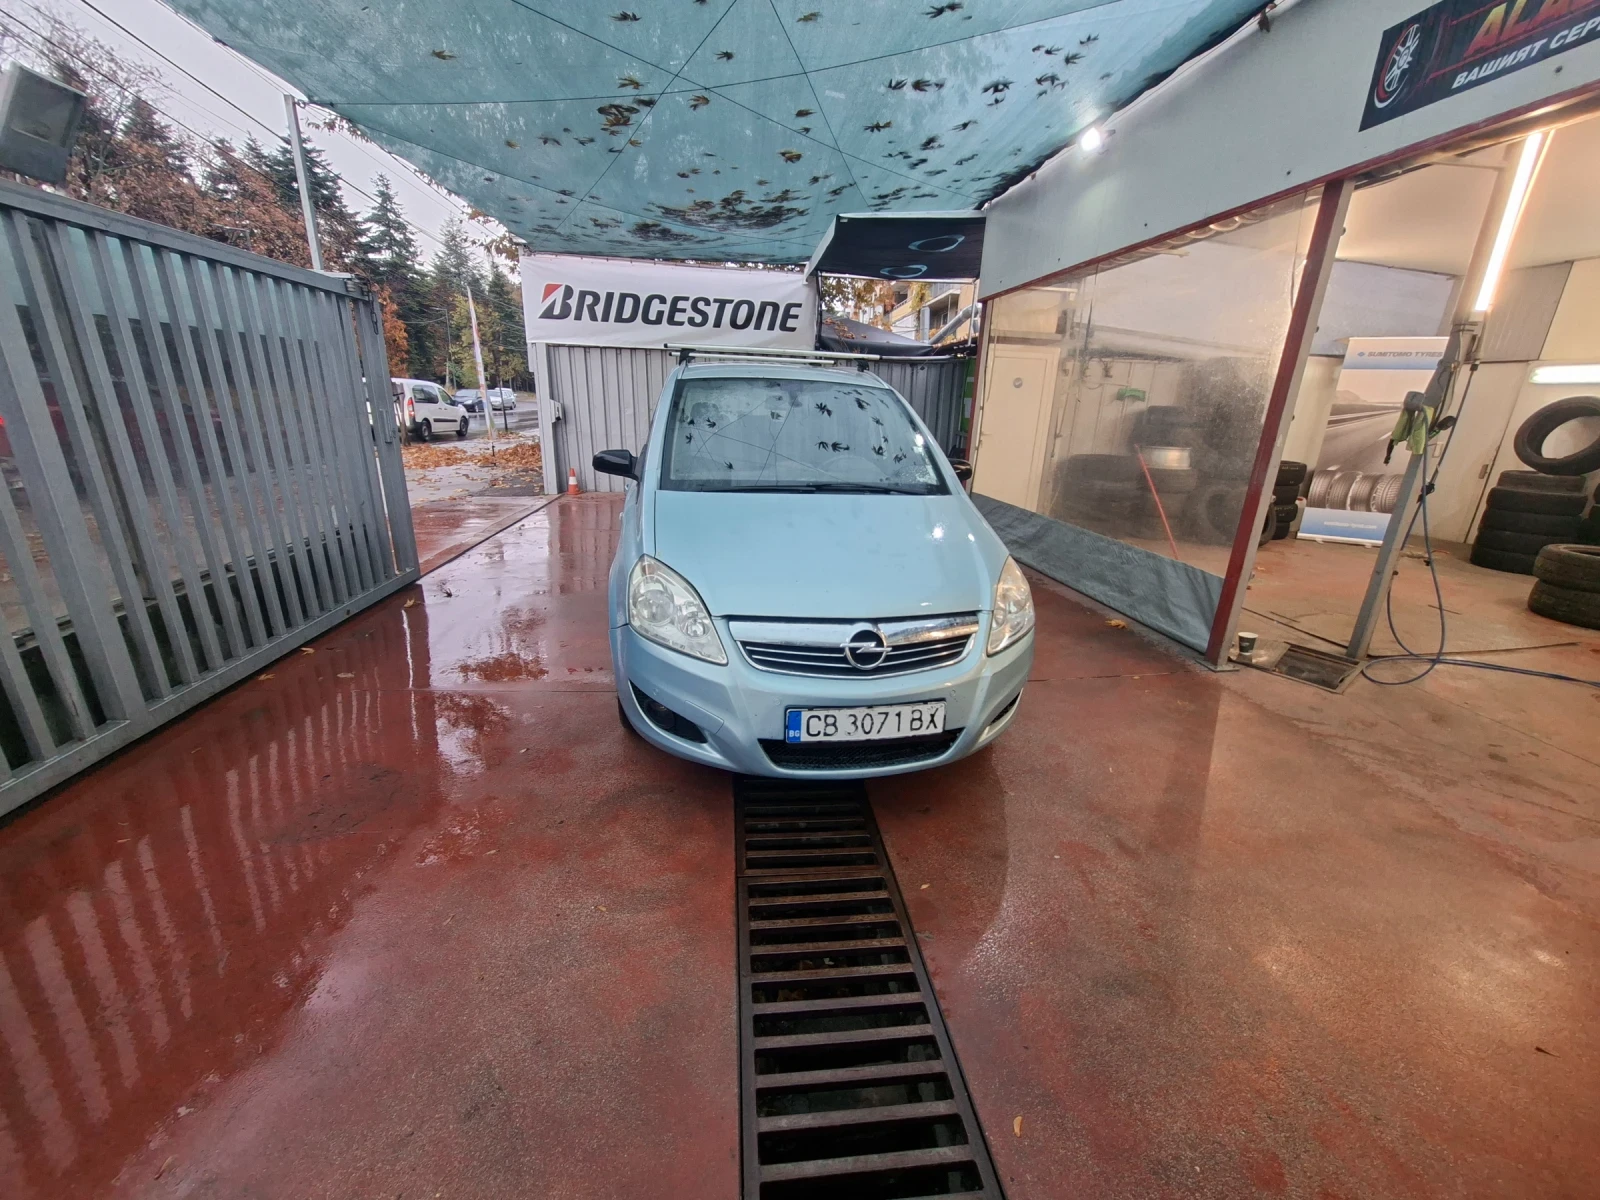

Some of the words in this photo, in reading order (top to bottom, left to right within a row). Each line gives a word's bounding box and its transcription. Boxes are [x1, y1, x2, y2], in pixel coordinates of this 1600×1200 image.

[1451, 38, 1548, 89] ВАШИЯТ
[1549, 15, 1600, 49] СЕР
[1463, 0, 1593, 58] ALA
[538, 283, 802, 332] BRIDGESTONE
[788, 729, 800, 738] BG
[806, 713, 839, 738] CB
[845, 711, 902, 735] 3071
[910, 707, 939, 732] BX
